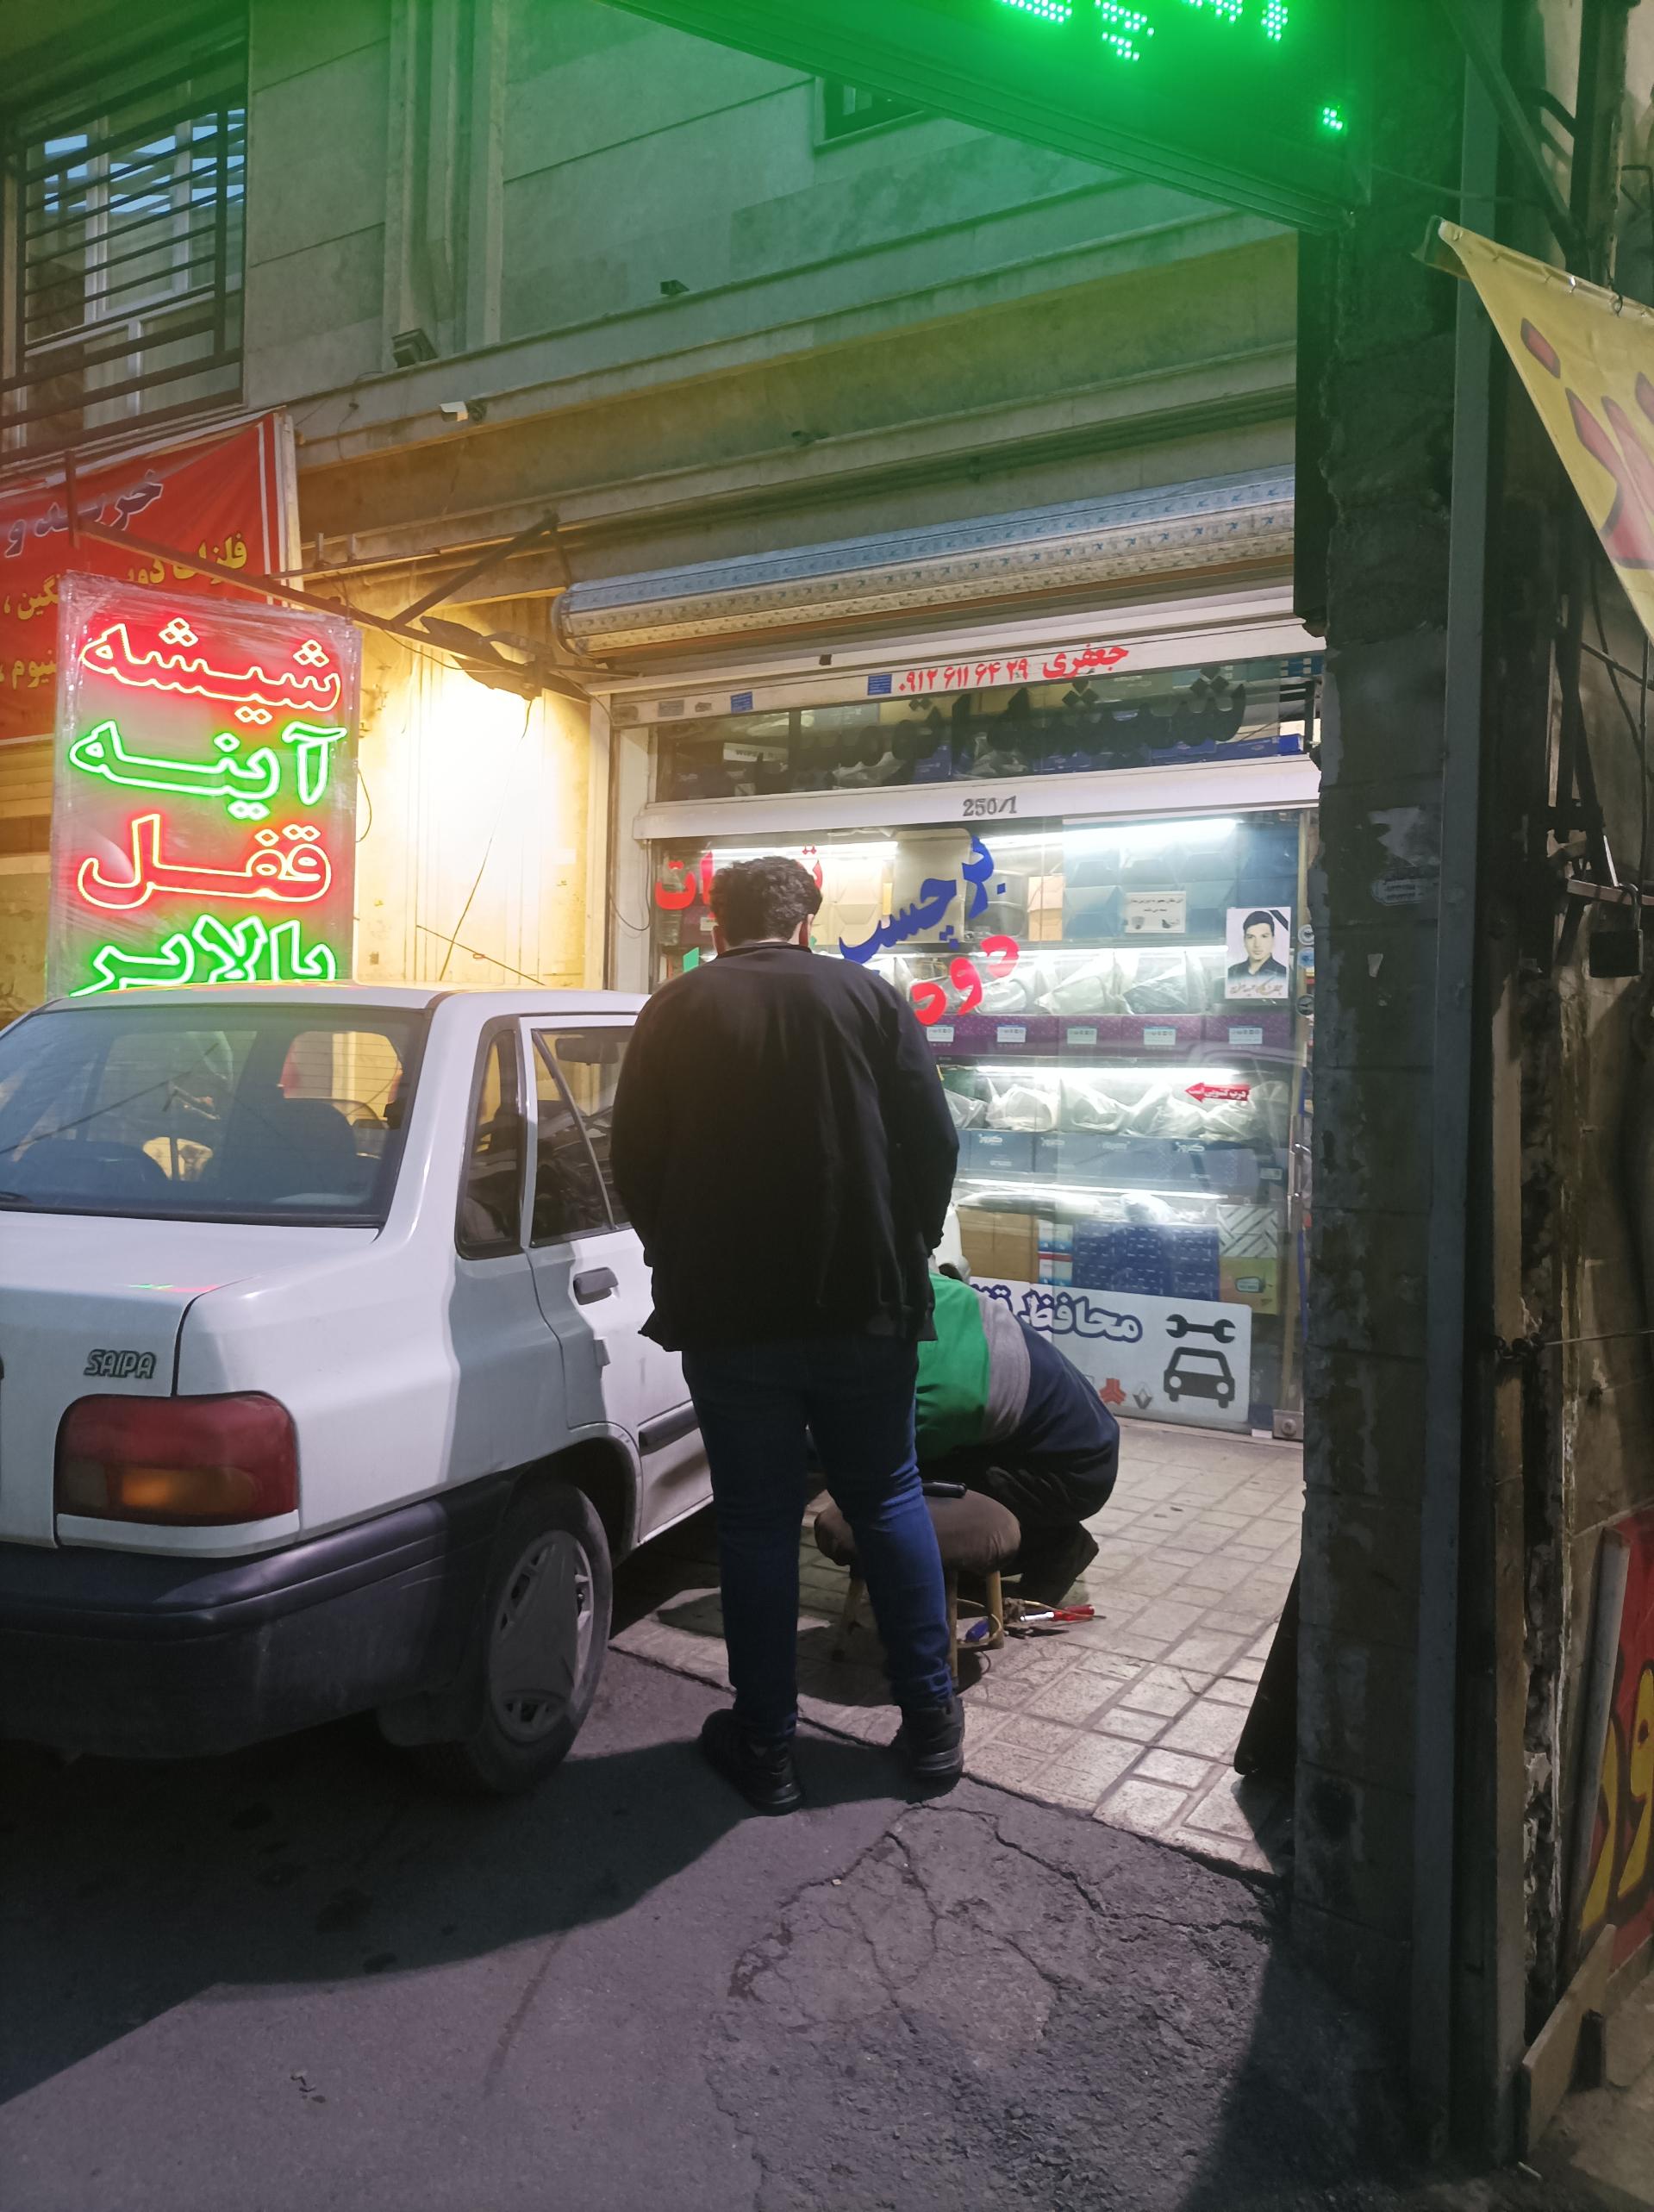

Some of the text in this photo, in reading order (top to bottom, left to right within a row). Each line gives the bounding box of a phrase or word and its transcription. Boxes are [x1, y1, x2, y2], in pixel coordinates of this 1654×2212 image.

[81, 617, 341, 724] شیشه
[943, 665, 970, 690] ۶۱۱
[1041, 643, 1129, 679] جعفری
[69, 721, 346, 819] آینه
[962, 795, 1018, 817] 250/1
[77, 814, 332, 910] قفل
[1017, 1289, 1143, 1344] محافظ
[83, 1348, 157, 1379] SAIPA
